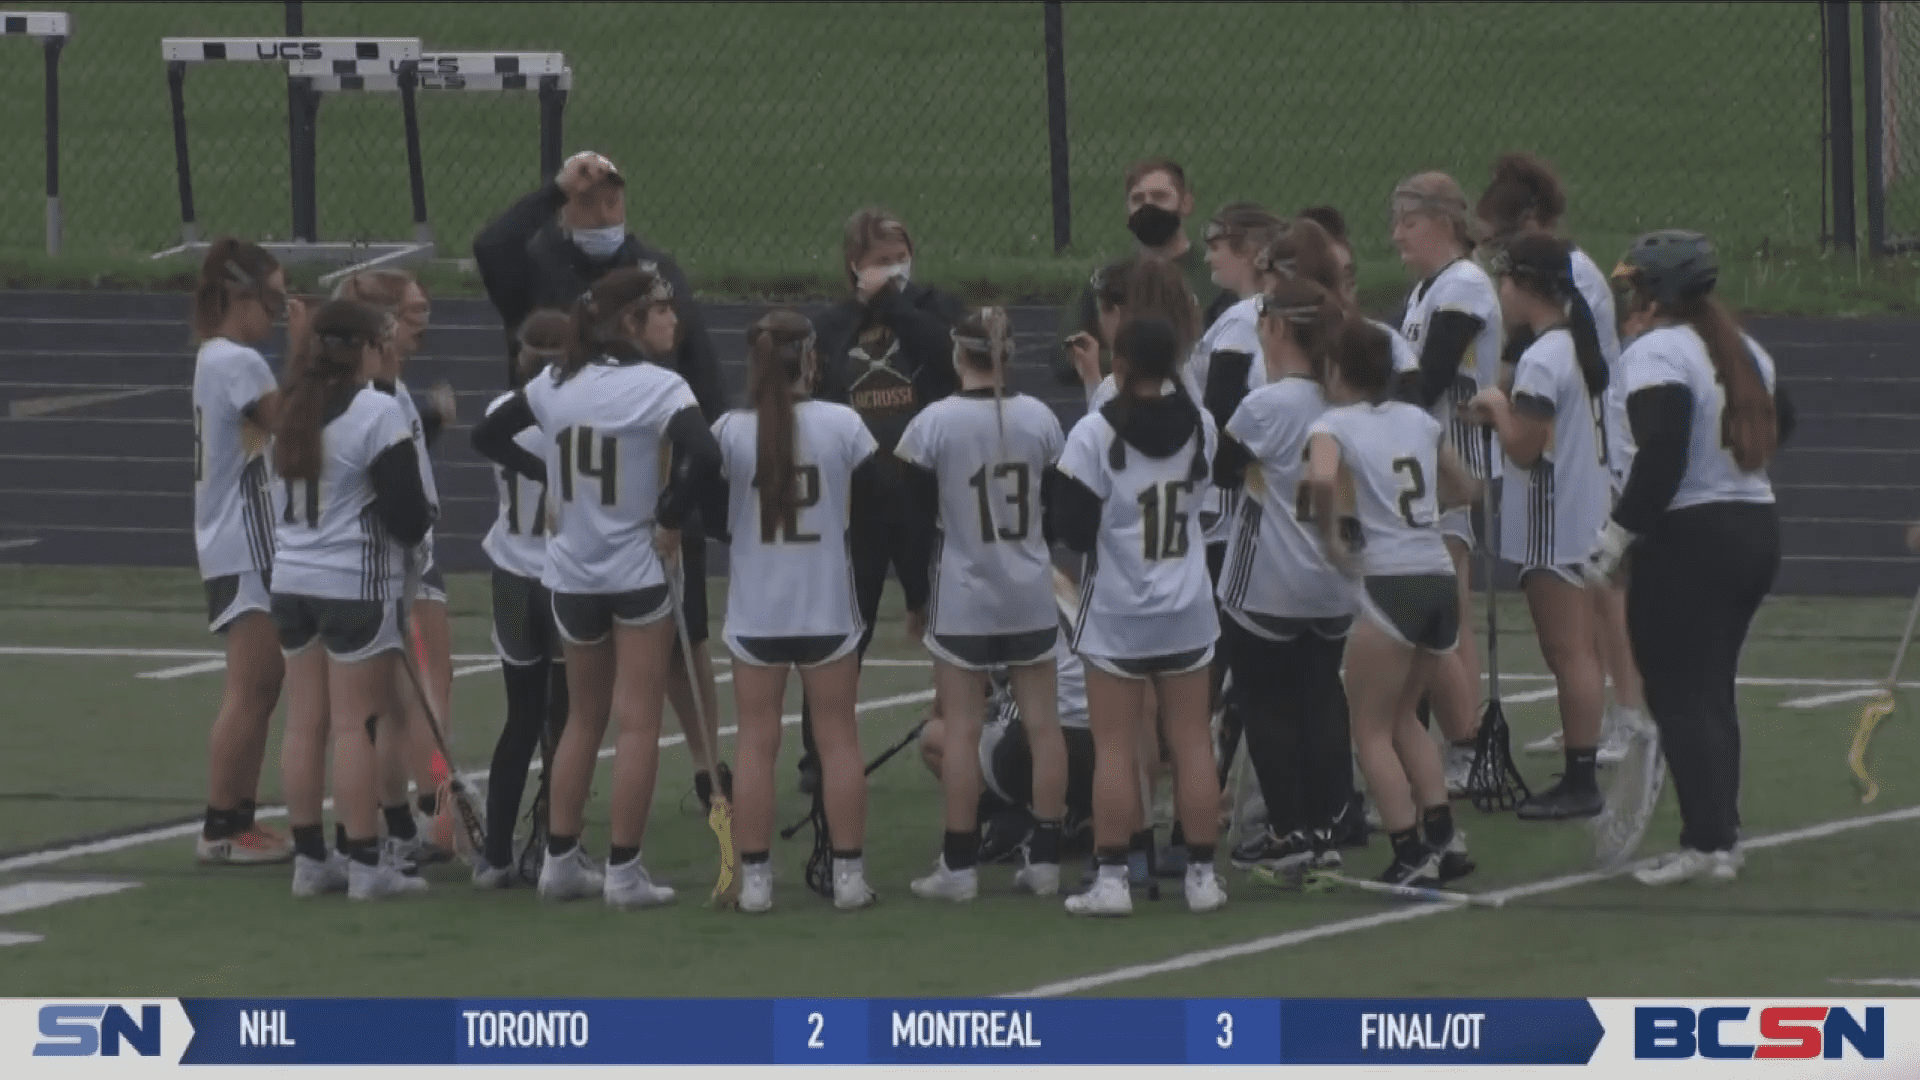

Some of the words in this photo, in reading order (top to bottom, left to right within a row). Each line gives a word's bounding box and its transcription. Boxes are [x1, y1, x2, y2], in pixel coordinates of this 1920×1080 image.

[257, 42, 322, 60] UCS
[555, 425, 617, 505] 14
[969, 462, 1030, 543] 13
[1393, 457, 1432, 528] 2
[1137, 481, 1193, 561] 16
